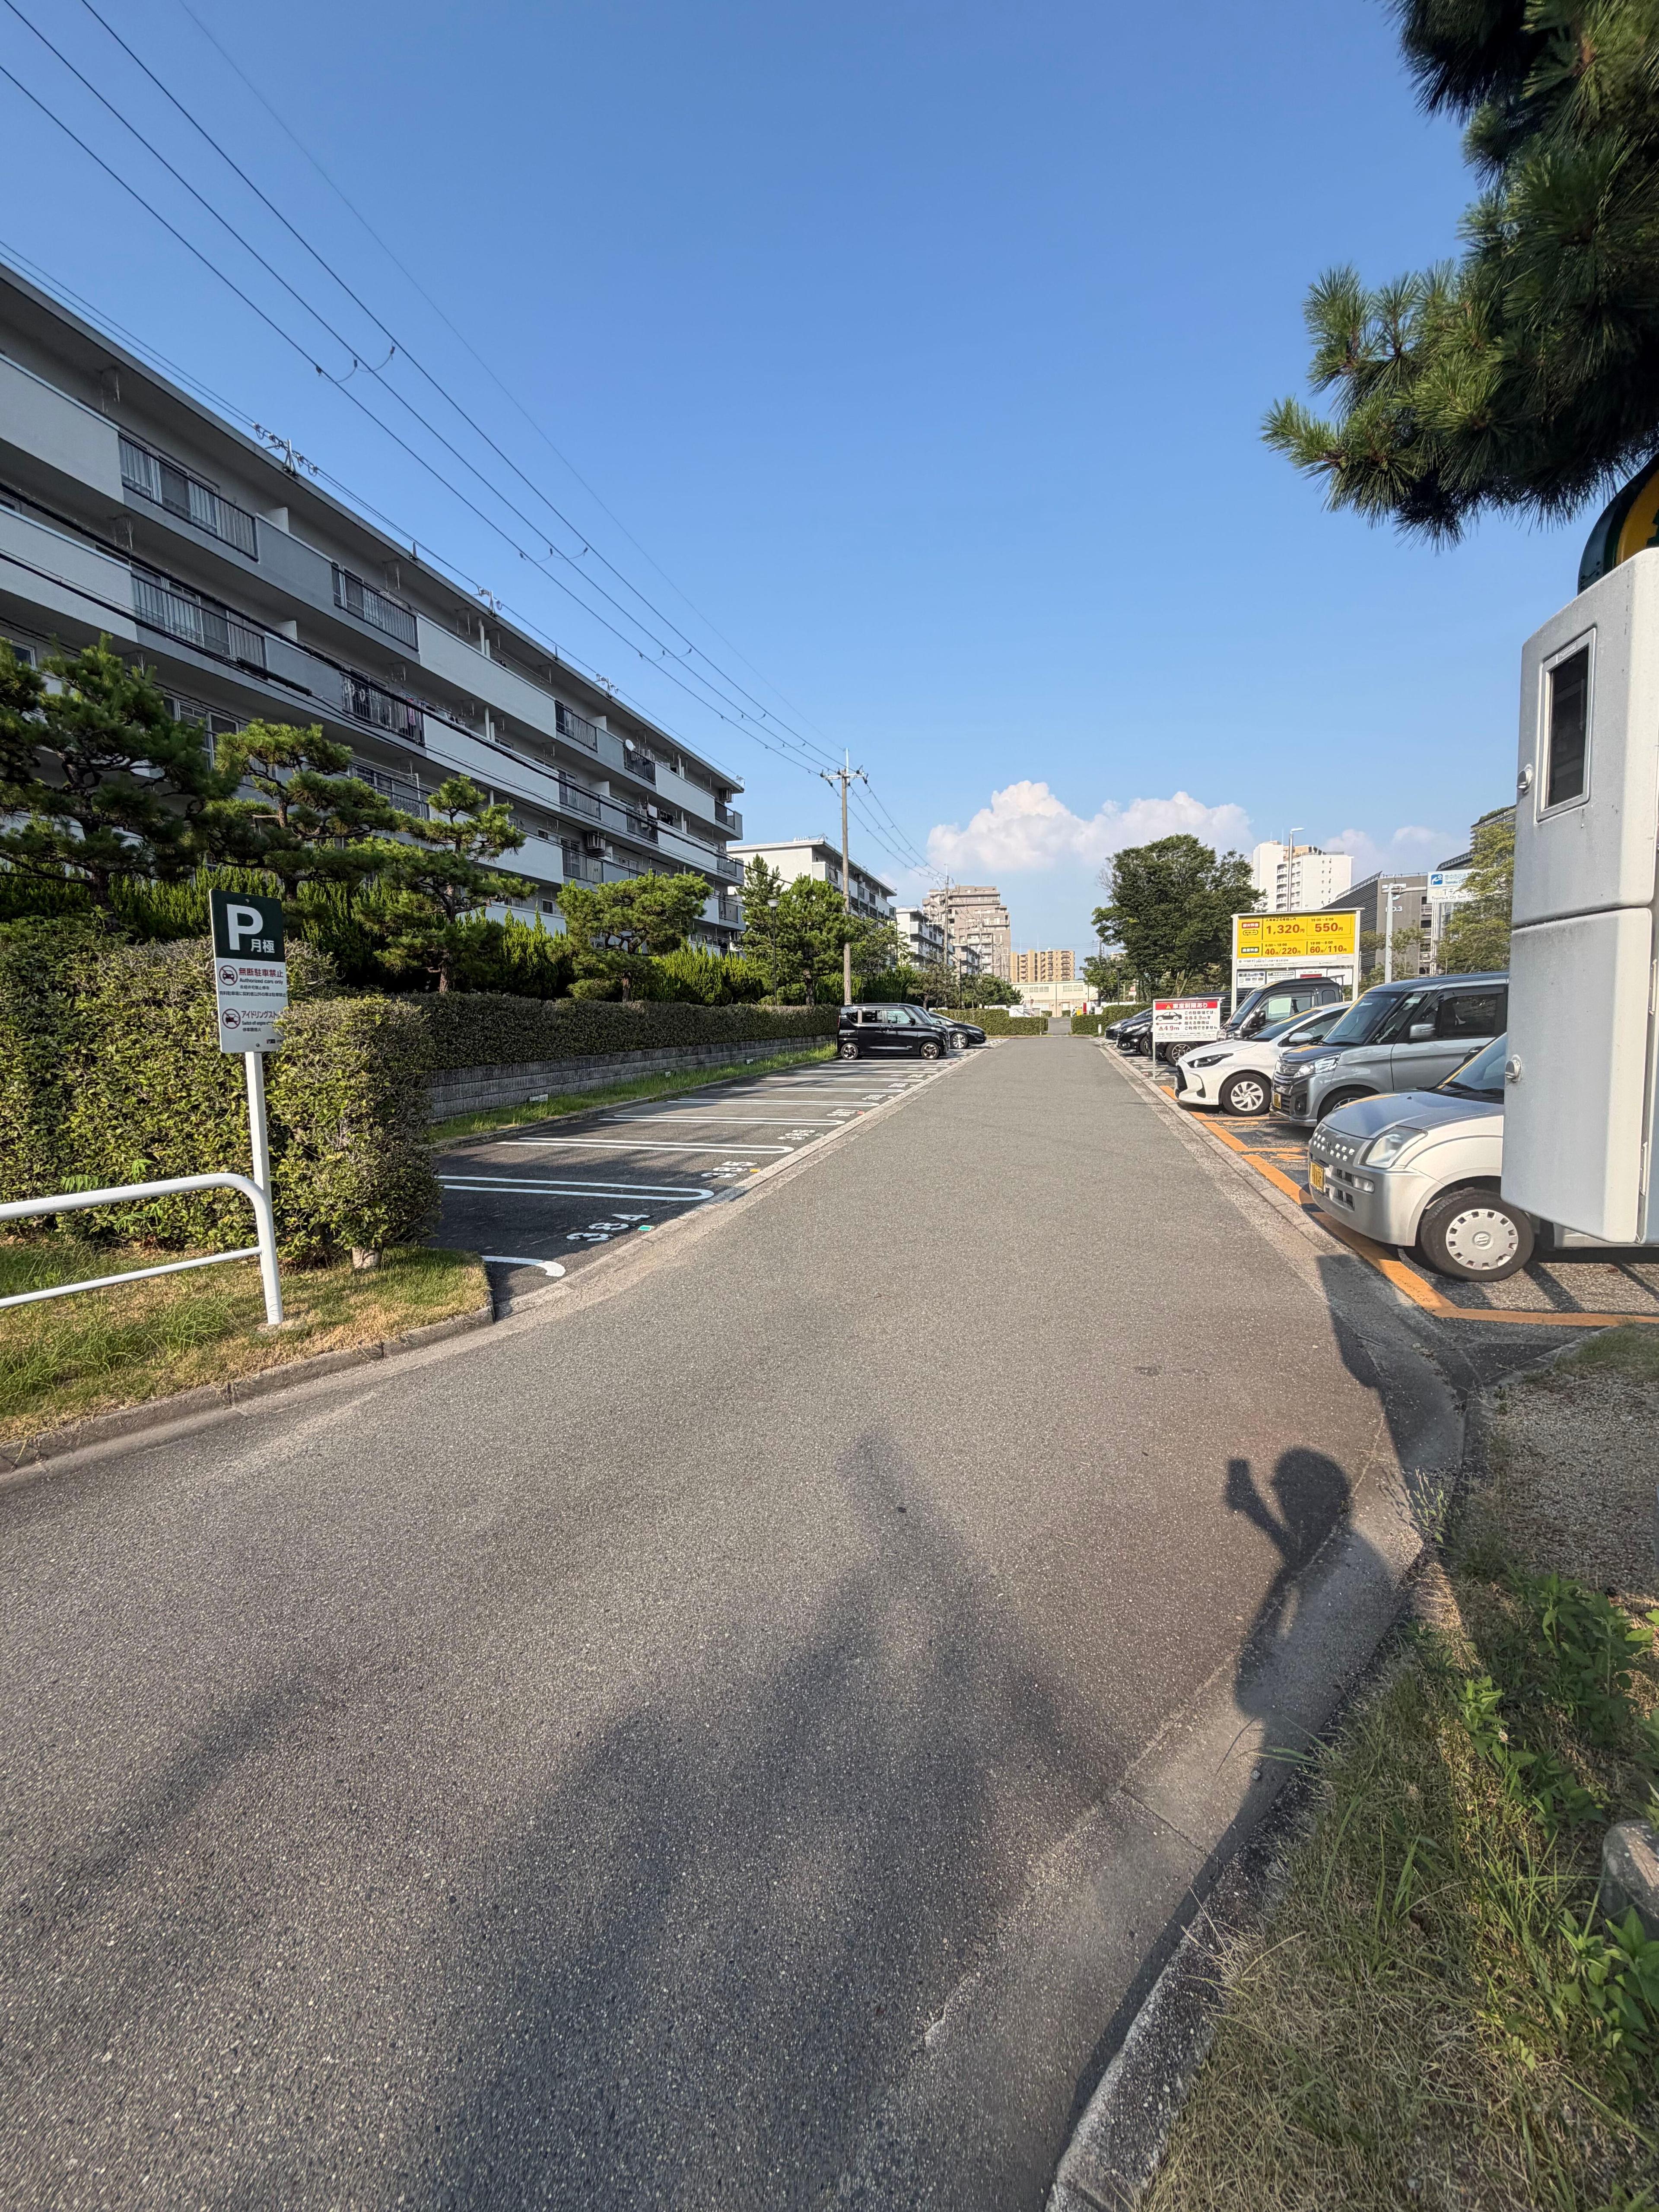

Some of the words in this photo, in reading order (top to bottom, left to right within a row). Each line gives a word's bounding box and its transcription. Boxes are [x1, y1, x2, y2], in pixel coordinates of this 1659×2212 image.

[227, 904, 263, 950] P
[1315, 922, 1343, 932] 550円
[251, 939, 275, 953] 月極
[238, 967, 284, 978] 無断駐車禁止
[241, 1010, 277, 1019] アイドリングスト
[701, 1161, 757, 1178] 385
[566, 1214, 651, 1242] 384
